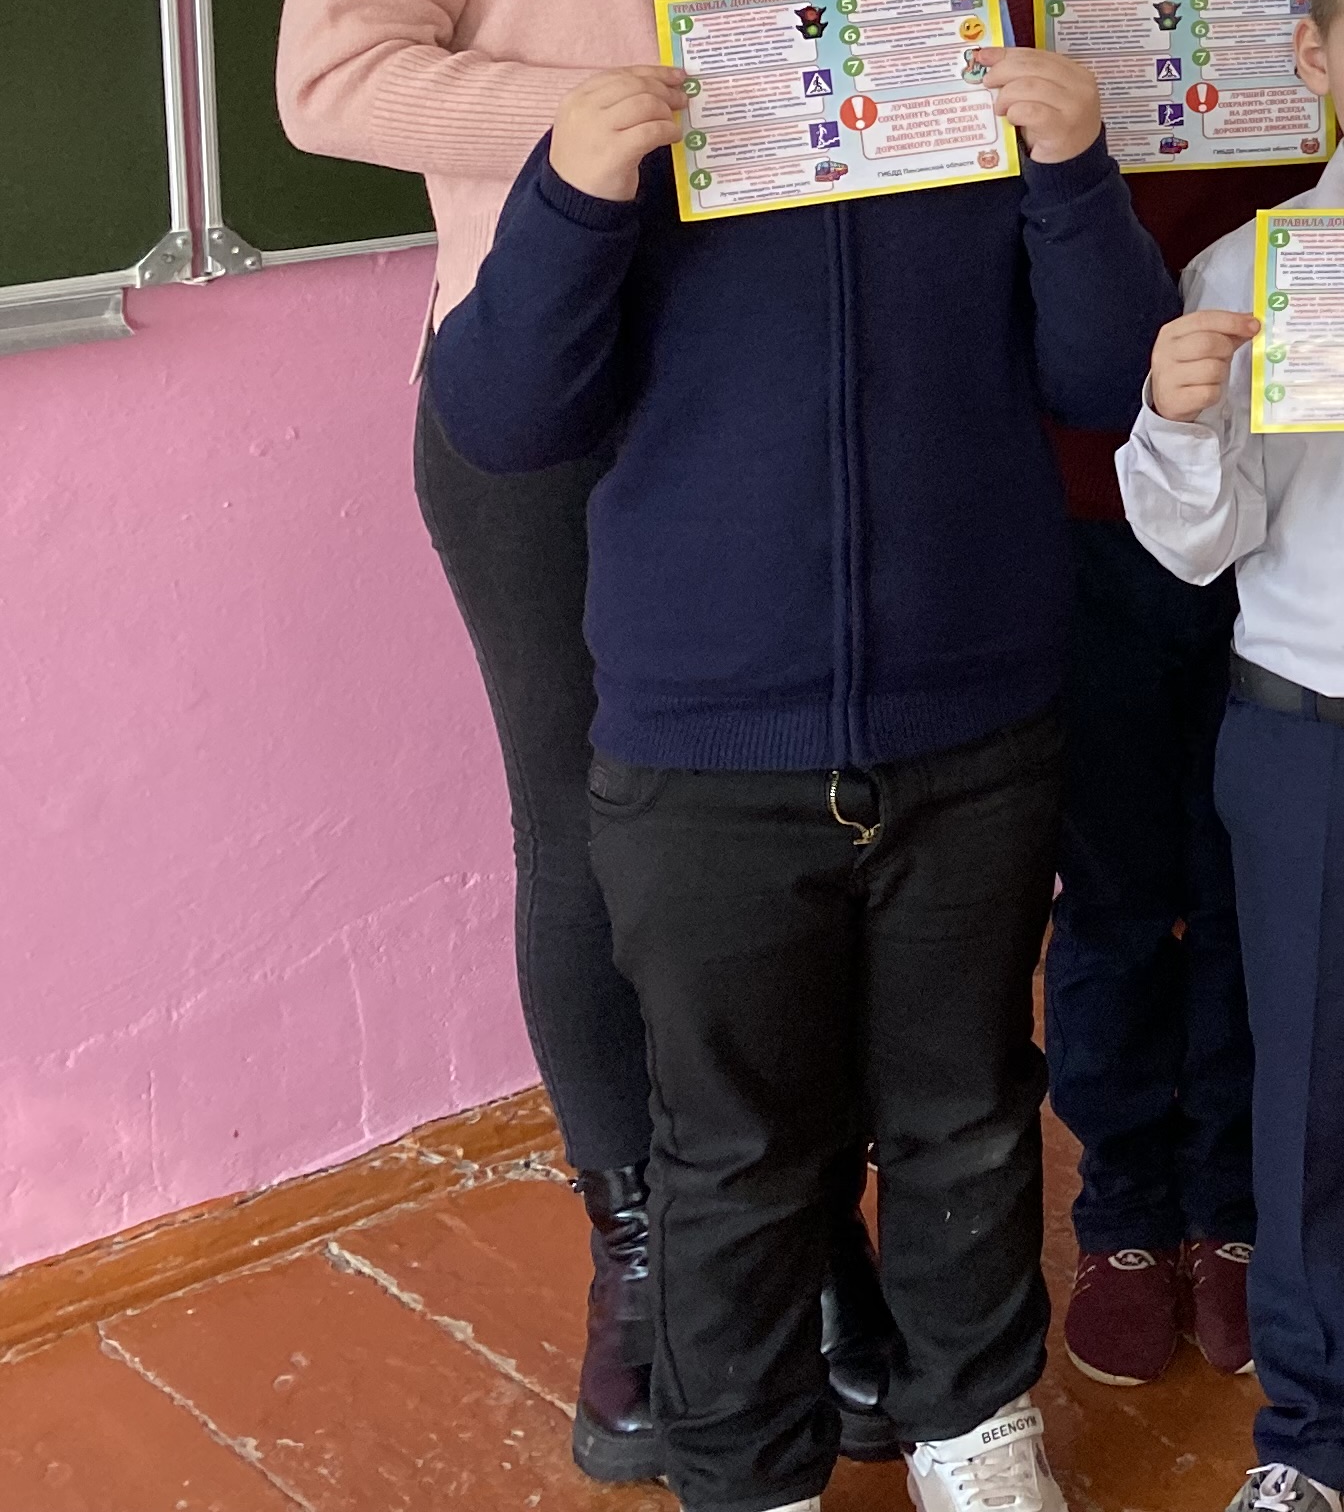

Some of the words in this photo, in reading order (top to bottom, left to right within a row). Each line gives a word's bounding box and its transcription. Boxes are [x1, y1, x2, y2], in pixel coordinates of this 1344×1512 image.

[673, 2, 728, 13] ПРАВИЛА
[842, 0, 853, 12] 5
[1051, 3, 1060, 14] 1
[677, 19, 687, 31] 1
[1196, 24, 1206, 34] 6
[844, 29, 857, 41] 6
[1196, 53, 1206, 63] 7
[848, 61, 858, 72] 7
[683, 83, 697, 94] 2
[690, 135, 702, 147] 3
[694, 173, 708, 186] 4
[1273, 217, 1324, 226] ПРАВИЛА
[1274, 233, 1284, 245] 1
[1271, 296, 1285, 308] 2
